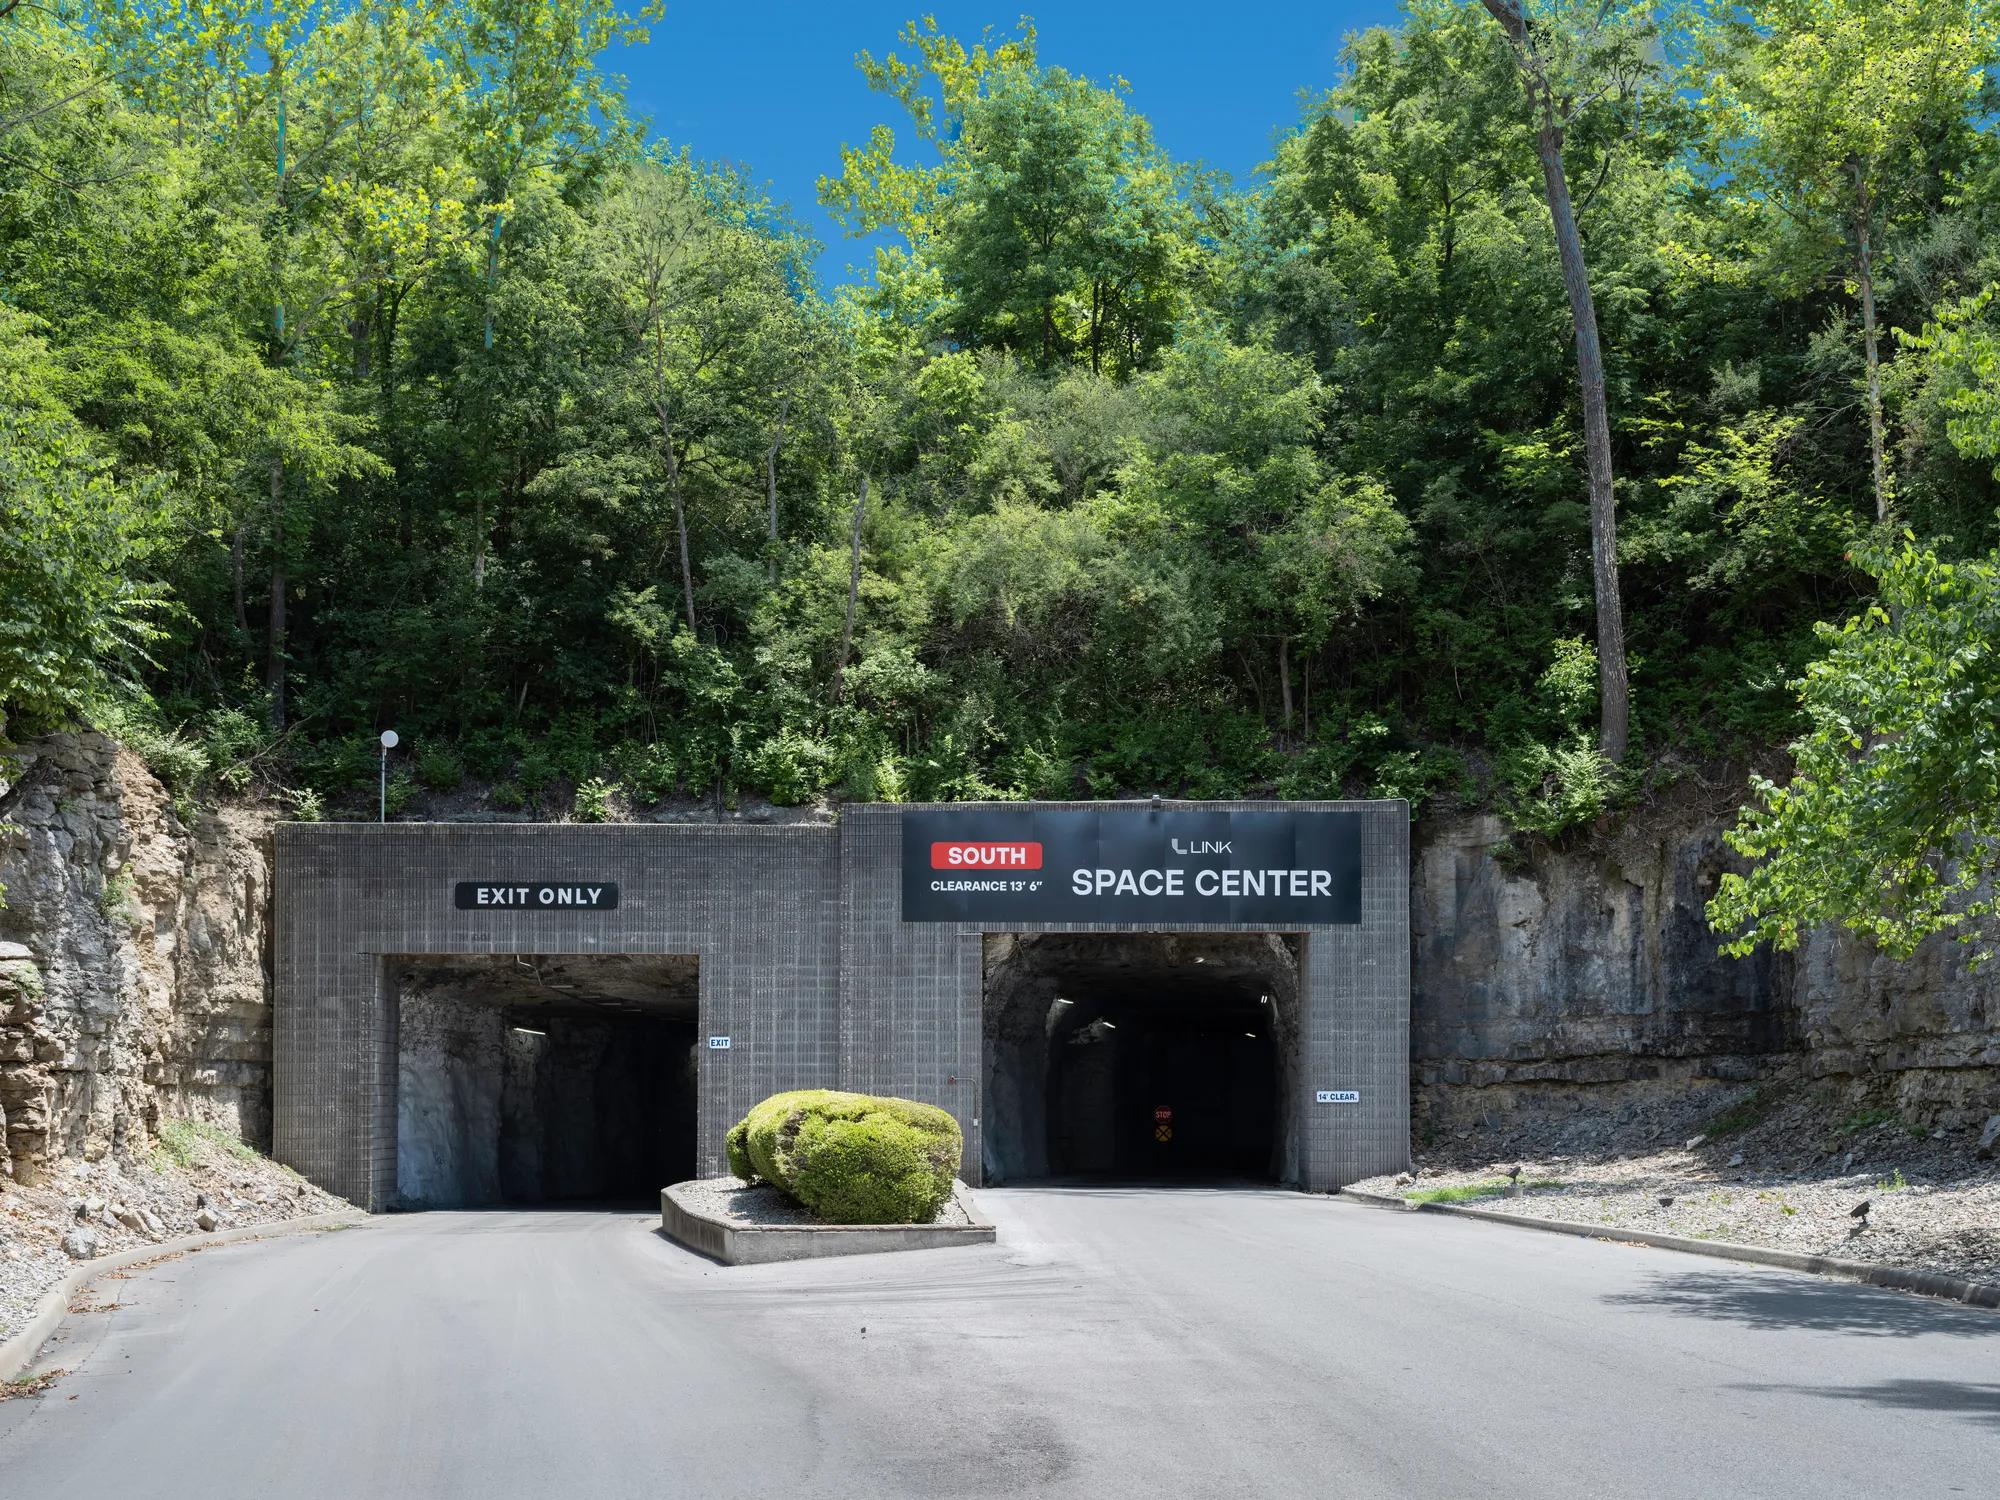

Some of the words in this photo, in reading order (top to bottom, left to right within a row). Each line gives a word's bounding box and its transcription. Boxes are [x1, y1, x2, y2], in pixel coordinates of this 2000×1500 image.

[1190, 840, 1232, 854] LINK
[948, 846, 1026, 865] SOUTH
[930, 880, 1007, 891] CLEARANCE
[1072, 868, 1184, 897] SPACE
[1195, 868, 1332, 897] CENTER
[477, 888, 530, 904] EXIT
[539, 888, 602, 904] ONLY
[1330, 1093, 1357, 1101] CLEAR.
